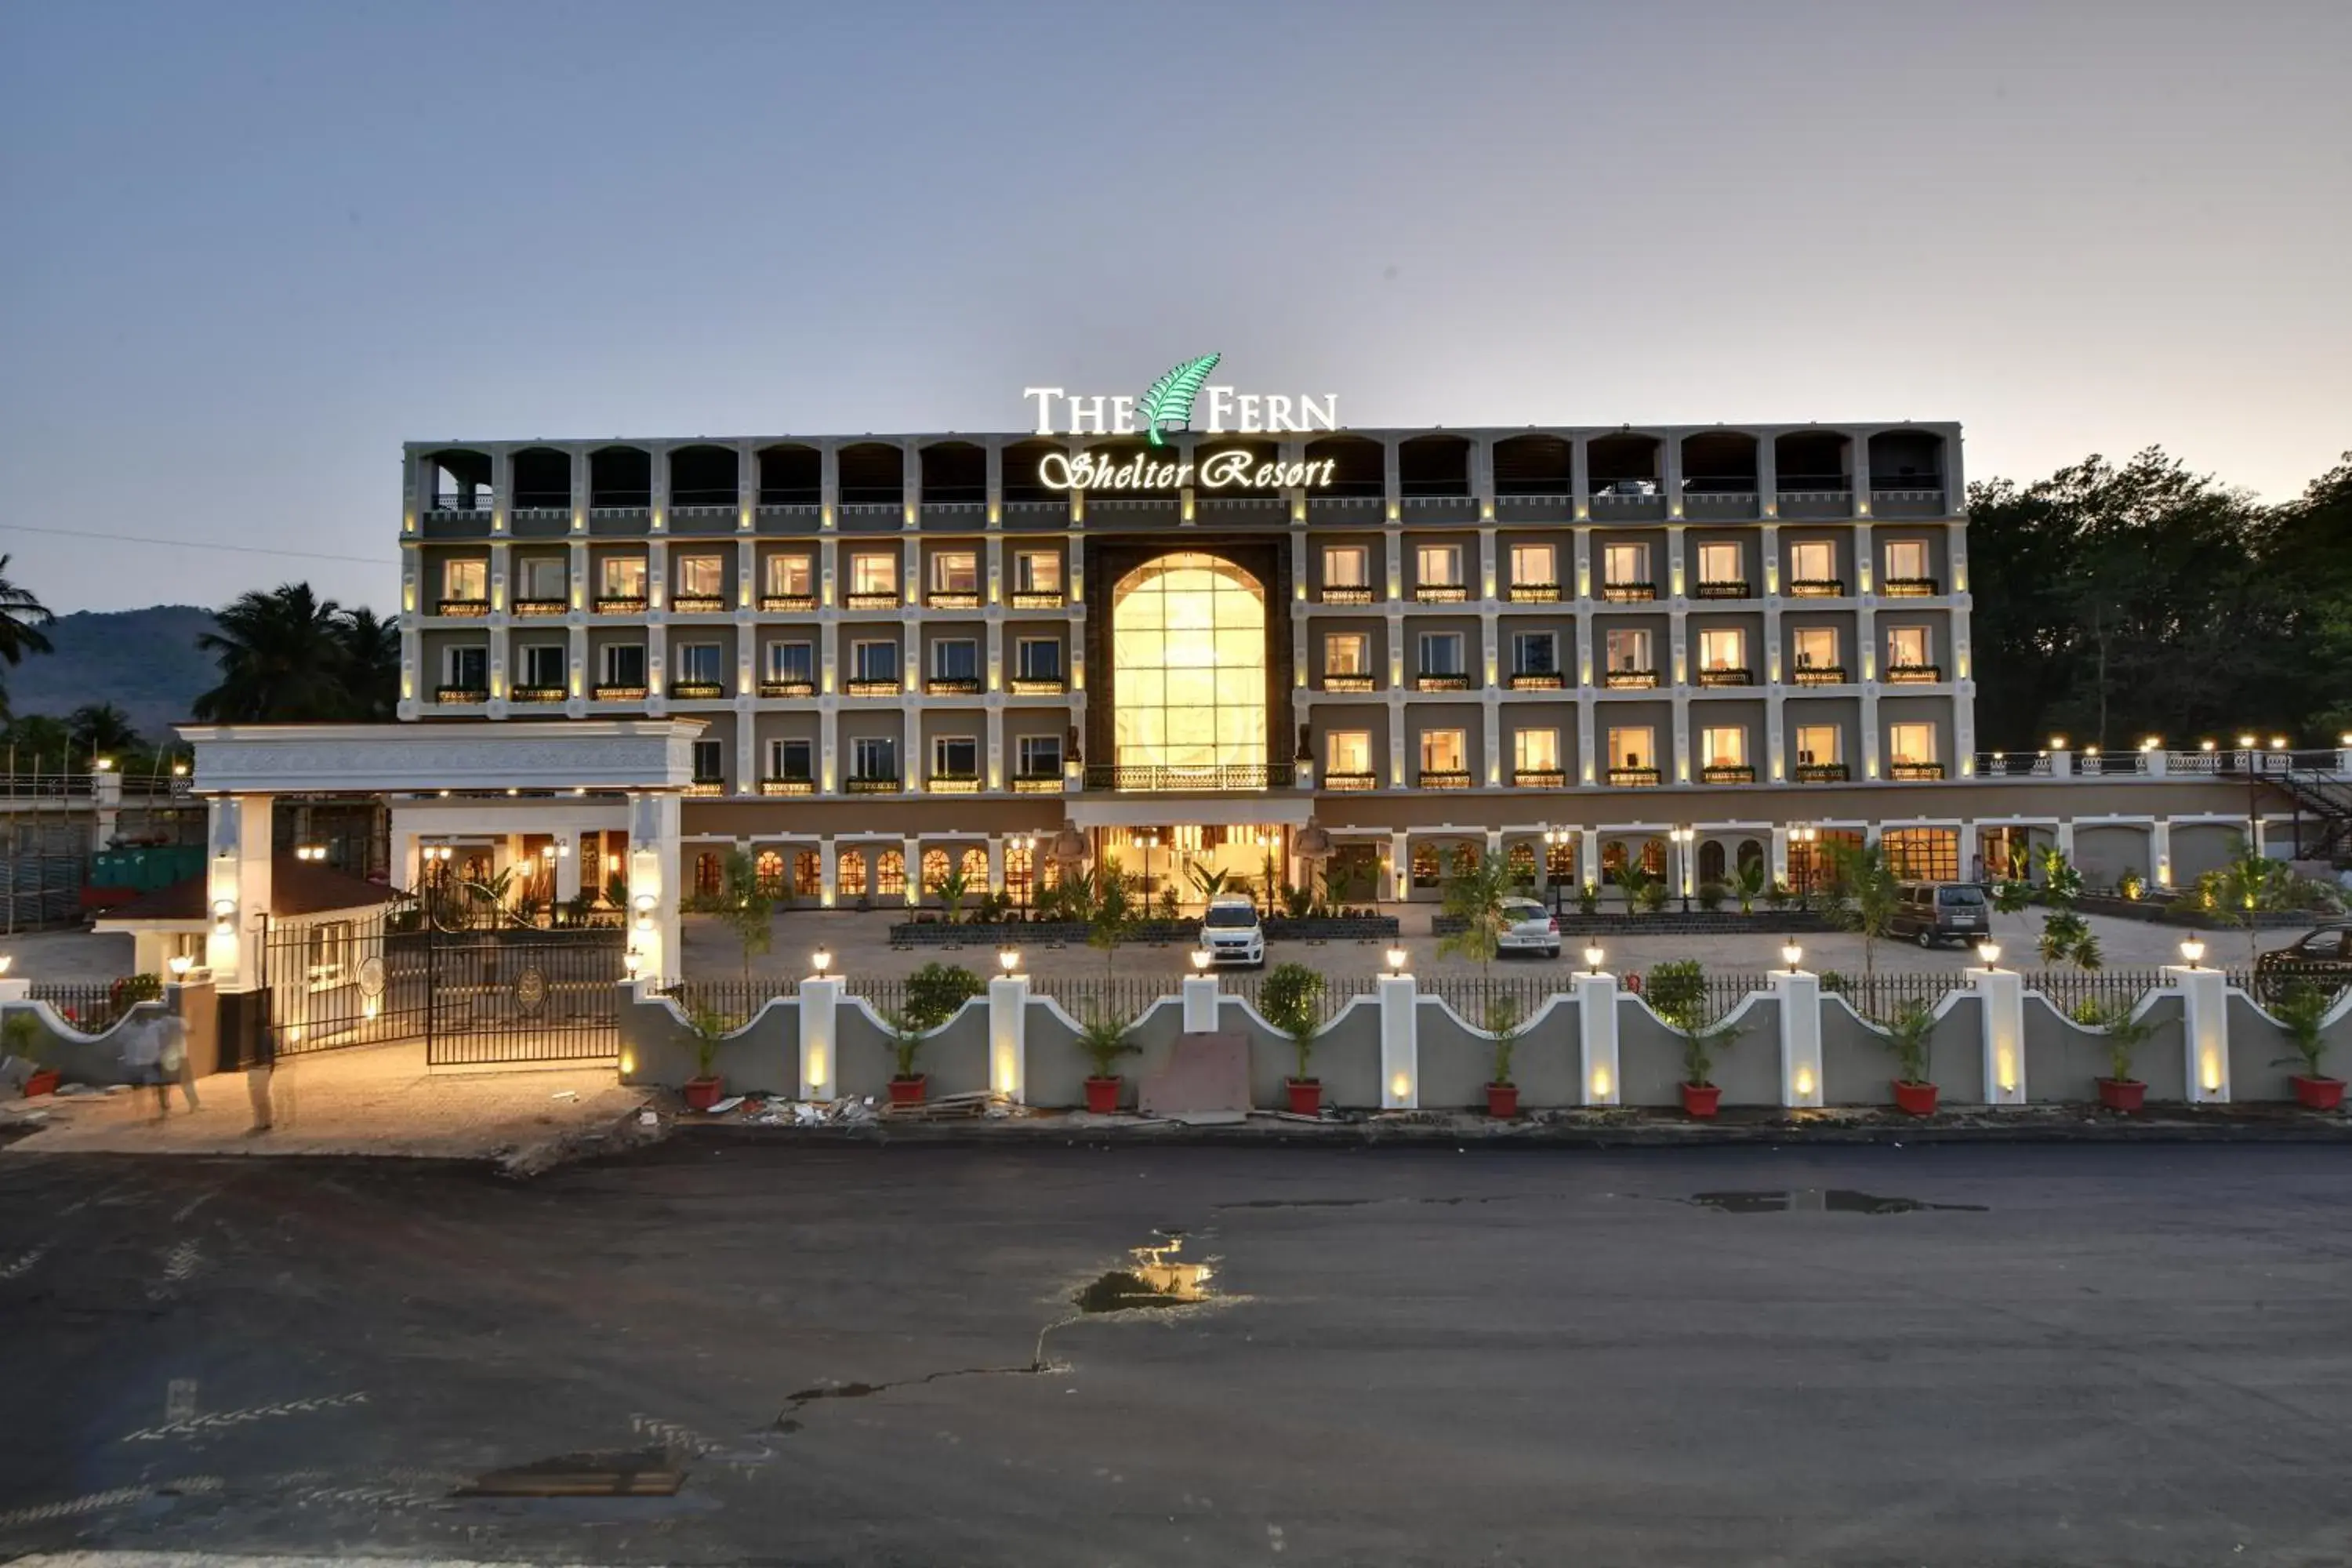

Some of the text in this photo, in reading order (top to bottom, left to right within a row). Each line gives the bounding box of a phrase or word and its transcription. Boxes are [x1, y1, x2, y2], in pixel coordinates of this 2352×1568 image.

[1024, 386, 1338, 435] THE FERN
[1039, 450, 1335, 489] Shelter Resort
